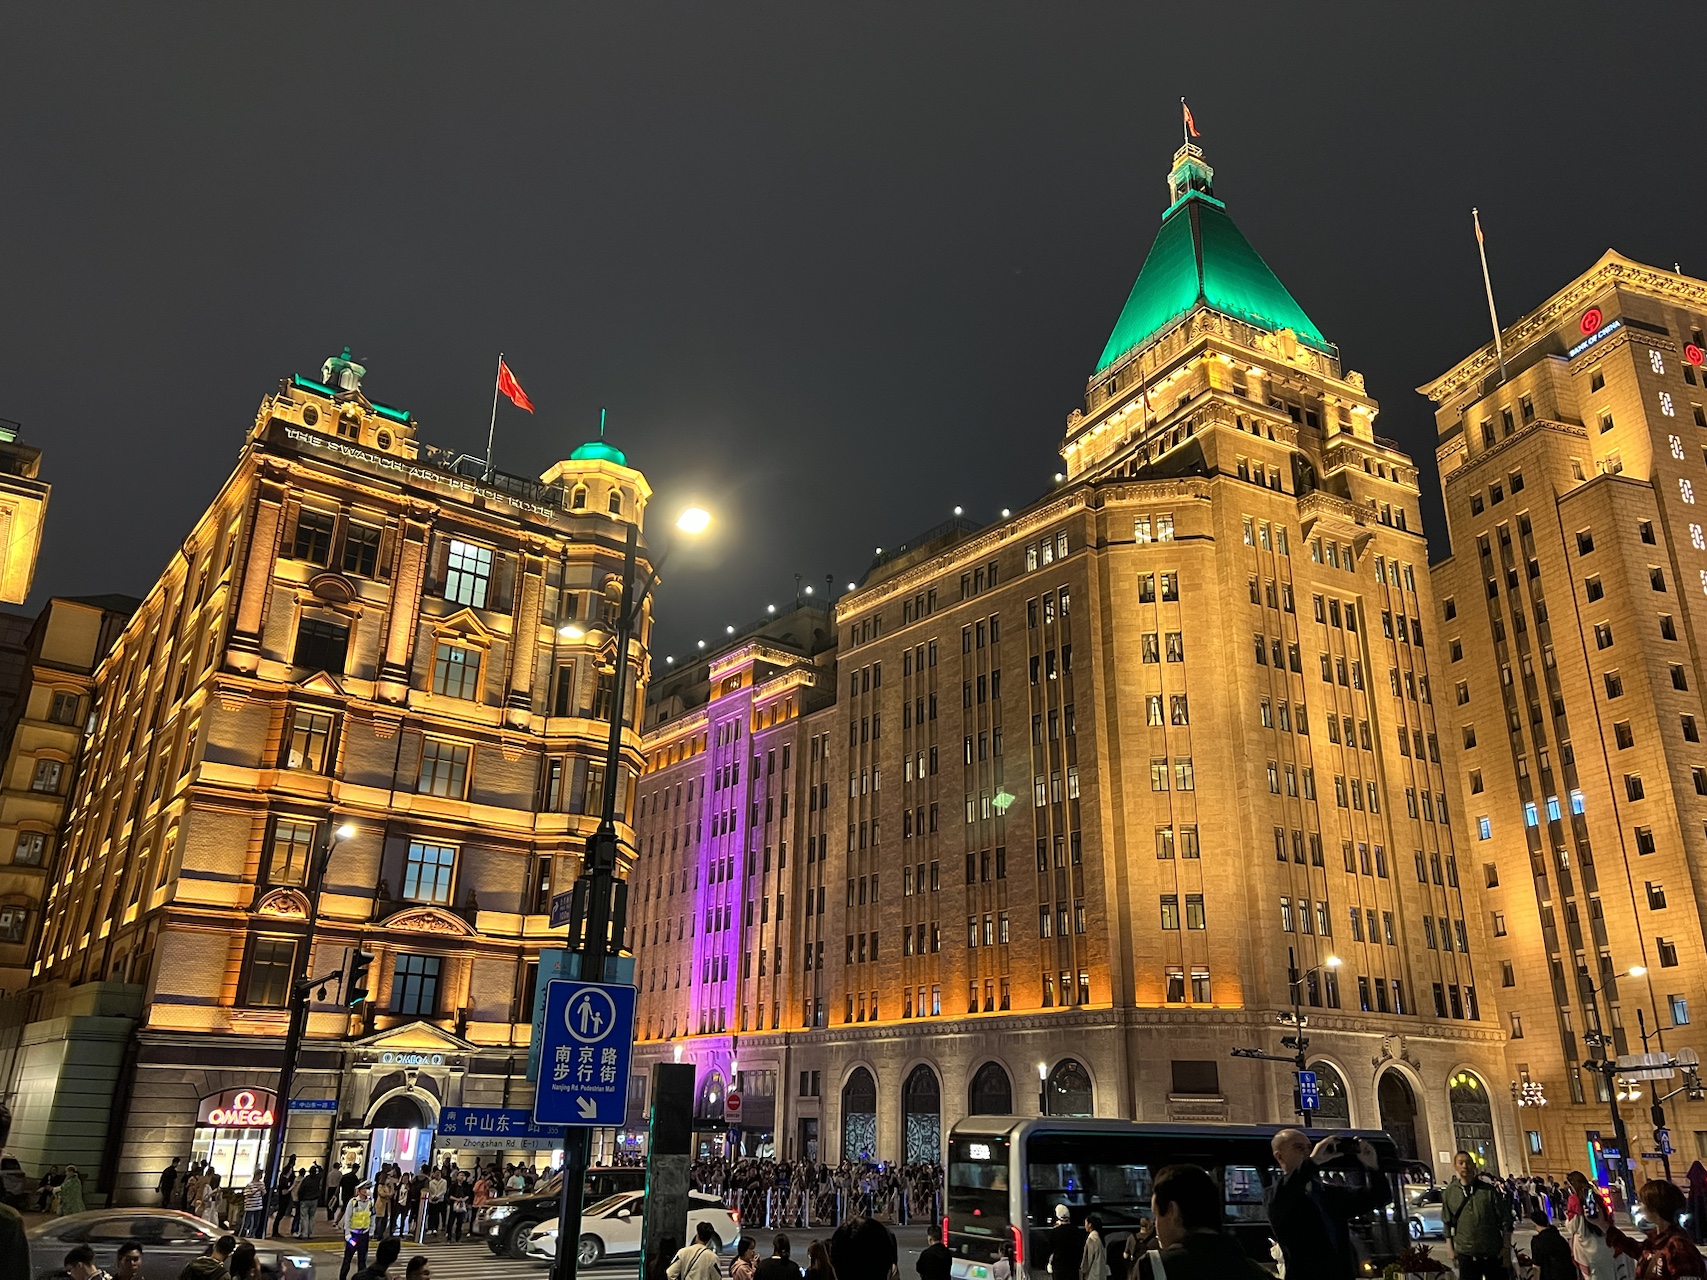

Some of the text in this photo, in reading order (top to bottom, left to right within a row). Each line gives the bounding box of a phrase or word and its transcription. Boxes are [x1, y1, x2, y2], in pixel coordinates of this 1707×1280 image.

[1569, 320, 1621, 357] BANK OF CHINA
[285, 427, 556, 519] THE SWATCH ART PEACE HOTEL
[396, 1054, 430, 1065] OMEGA
[555, 1045, 617, 1065] 南京路
[553, 1063, 617, 1083] 步行街
[552, 1084, 570, 1092] Nanjing
[208, 1109, 274, 1125] OMEGA
[447, 1111, 457, 1120] 南
[444, 1124, 457, 1132] 295
[463, 1139, 502, 1148] Zhongshan
[521, 1140, 539, 1149] (E-1)
